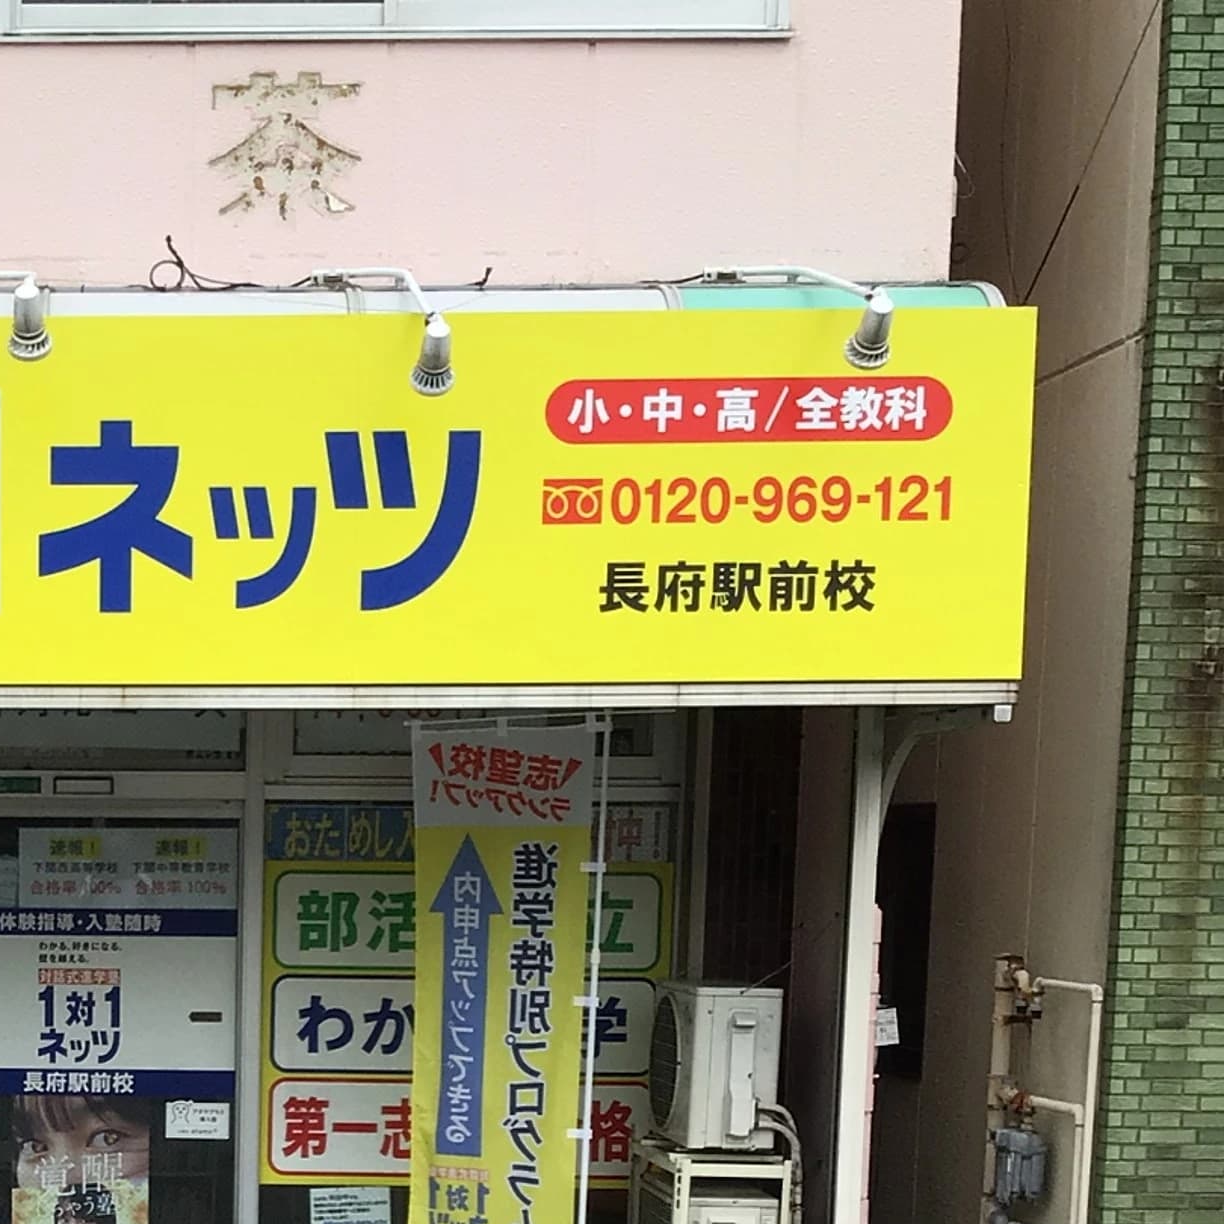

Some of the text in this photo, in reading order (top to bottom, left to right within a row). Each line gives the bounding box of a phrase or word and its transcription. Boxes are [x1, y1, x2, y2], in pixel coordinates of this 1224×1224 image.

[610, 475, 952, 525] 0120-969-121
[599, 560, 877, 613] 長府駅前校
[38, 986, 121, 1028] 1対1
[37, 1029, 121, 1064] ネッツ
[23, 1071, 136, 1095] 長府駅前校
